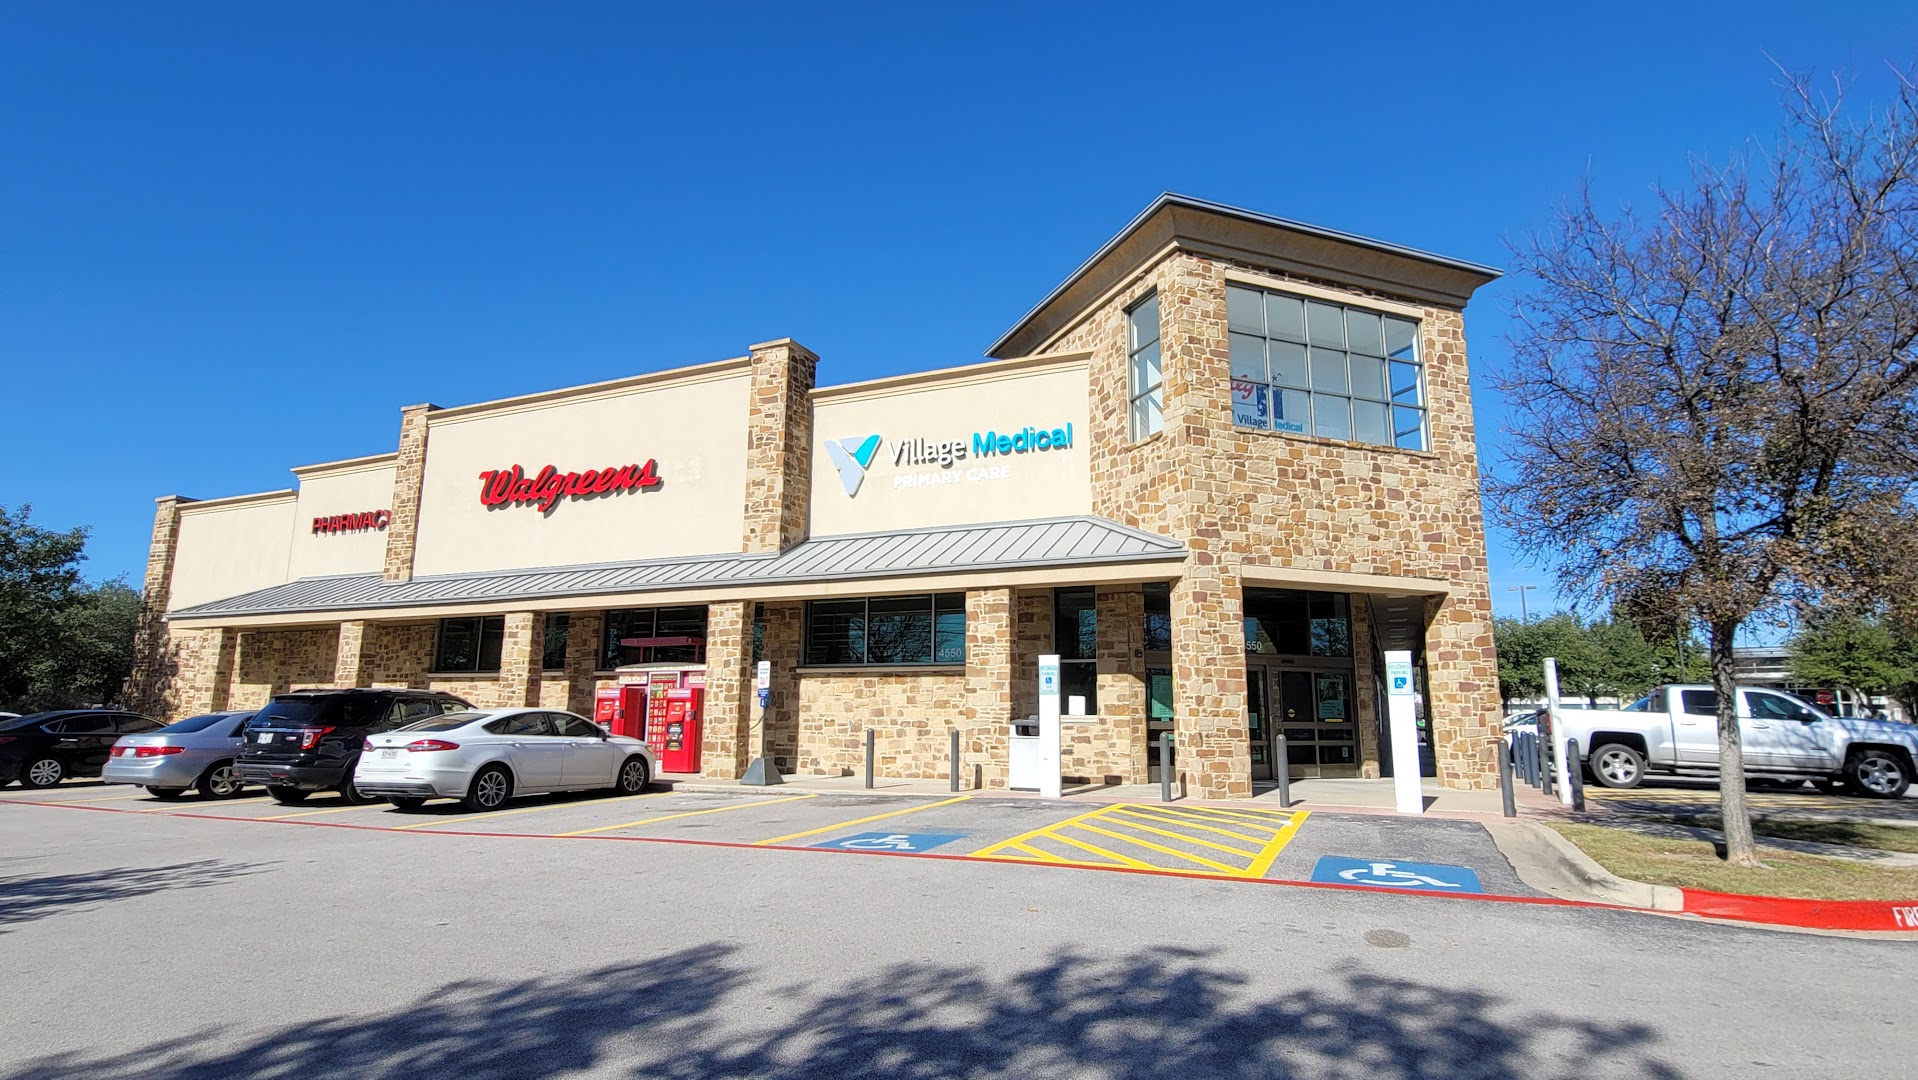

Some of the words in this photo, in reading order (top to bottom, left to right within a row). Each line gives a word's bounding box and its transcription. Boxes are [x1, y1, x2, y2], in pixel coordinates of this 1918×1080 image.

[1237, 413, 1268, 429] Village
[887, 437, 967, 467] Village
[973, 422, 1073, 455] Medical
[479, 458, 660, 512] Walgreens
[893, 469, 962, 489] PRIMARY
[966, 465, 1012, 484] CARE
[939, 648, 962, 658] 4550
[1246, 640, 1263, 651] 550
